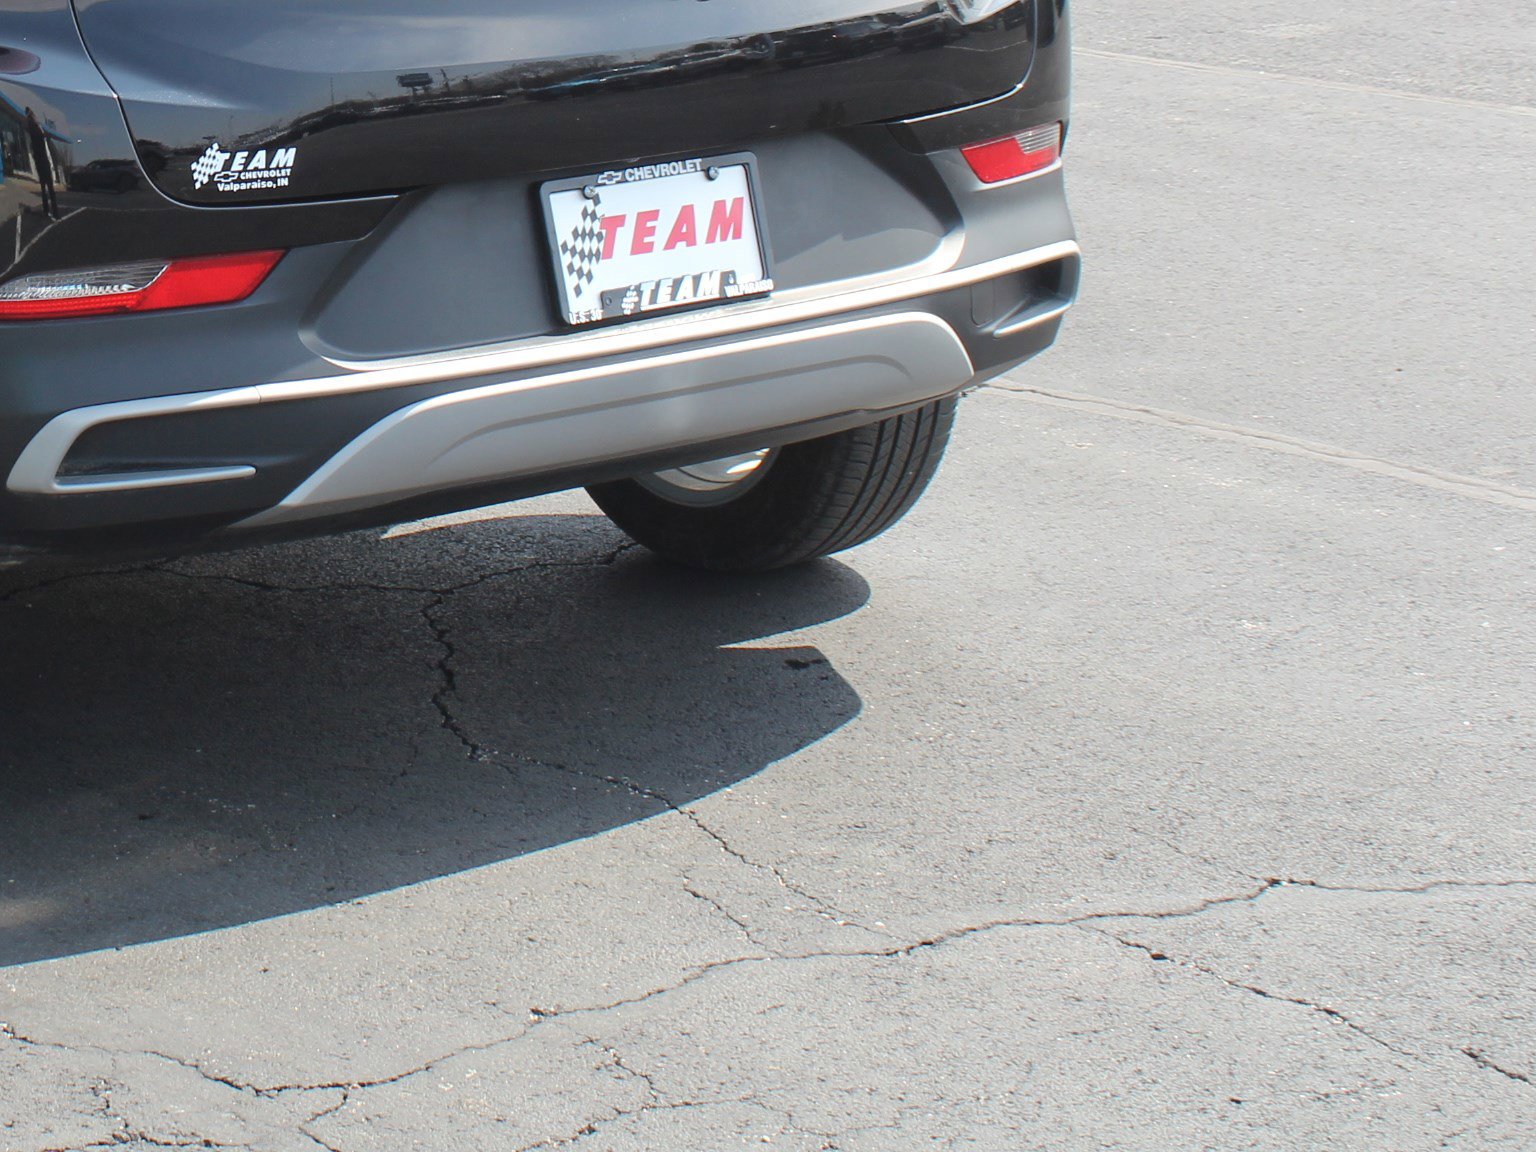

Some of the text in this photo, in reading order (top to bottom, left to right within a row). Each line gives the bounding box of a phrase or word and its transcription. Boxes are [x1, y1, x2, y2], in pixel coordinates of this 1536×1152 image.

[215, 147, 297, 173] TEAM
[624, 158, 704, 182] CHEVROLET
[239, 168, 292, 180] CHEVROLET
[599, 197, 745, 260] TEAM
[639, 270, 722, 310] TEAM
[724, 278, 775, 298] VALPARAISO
